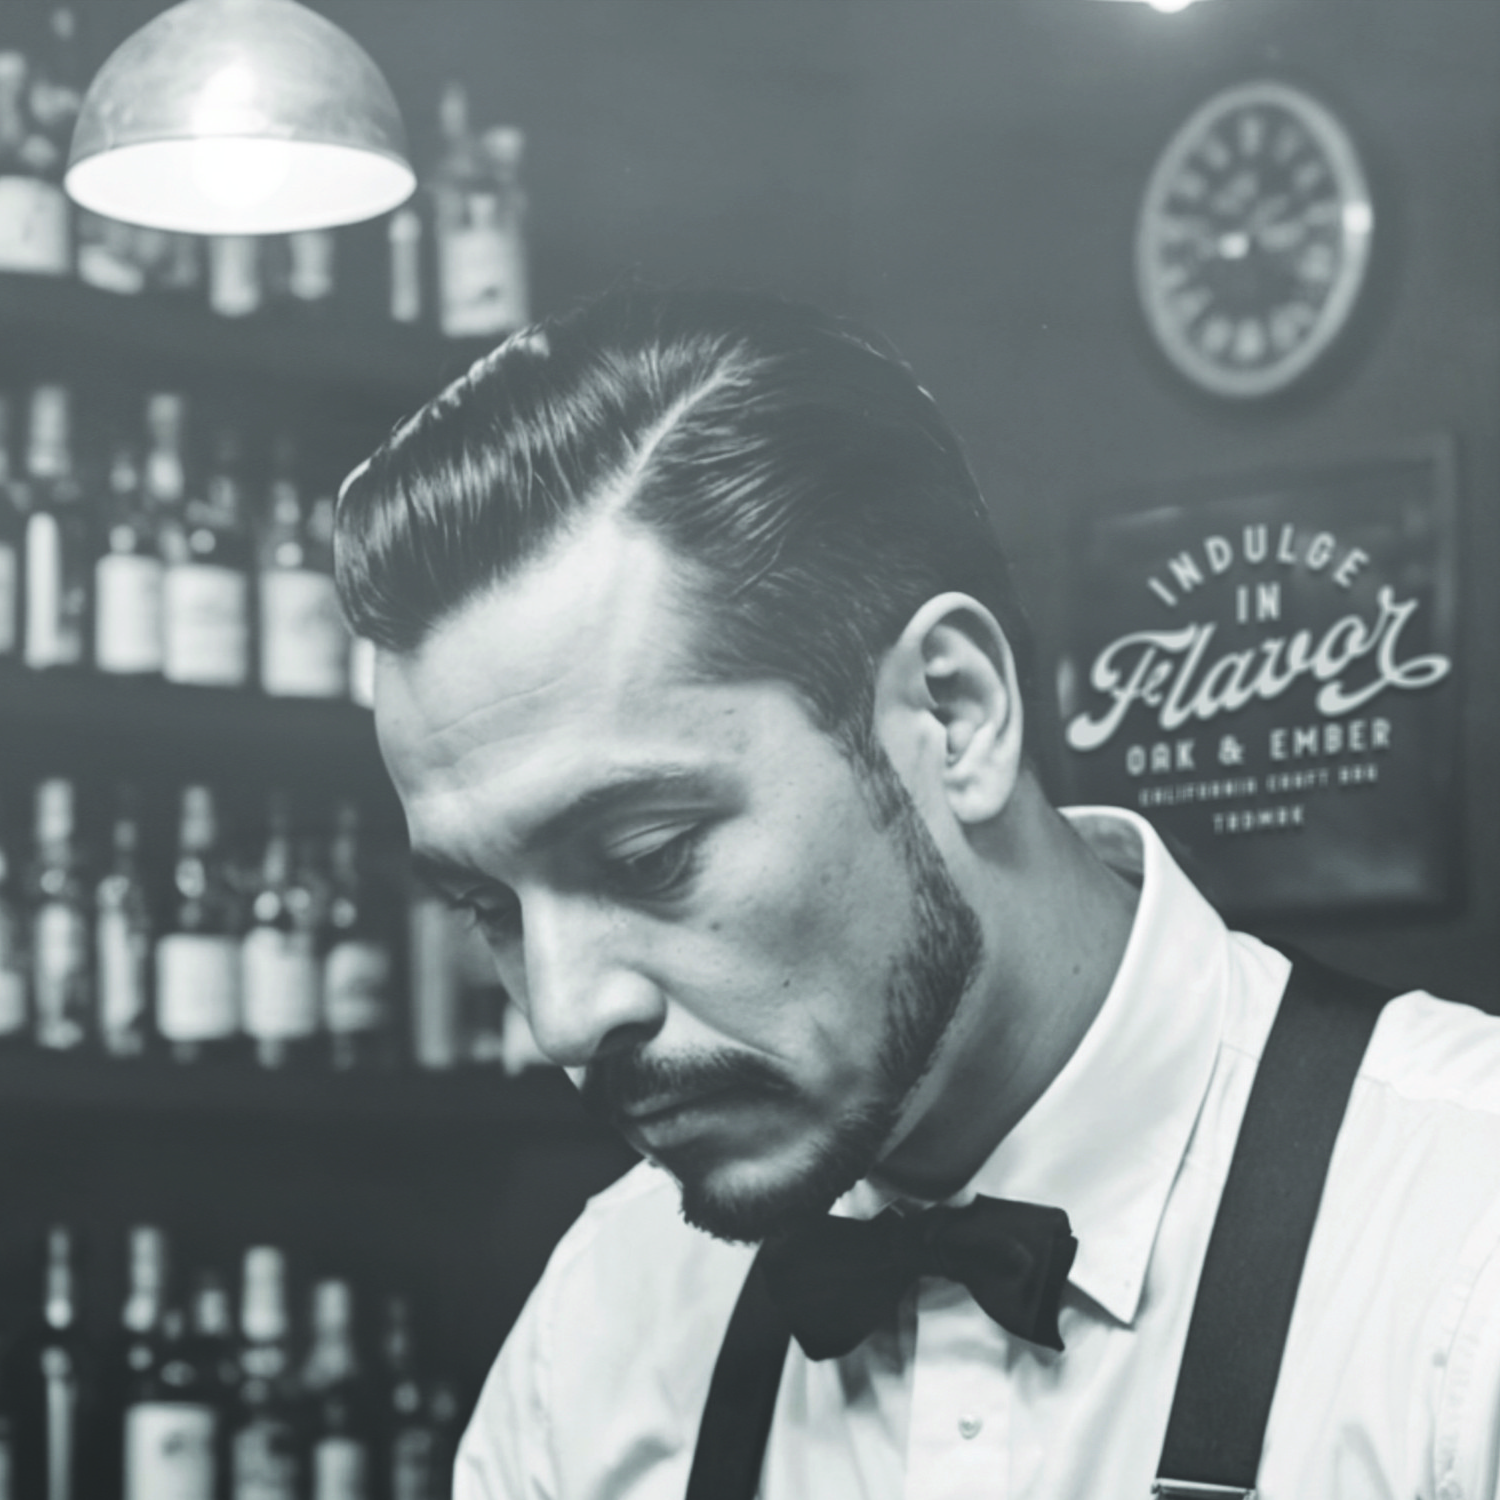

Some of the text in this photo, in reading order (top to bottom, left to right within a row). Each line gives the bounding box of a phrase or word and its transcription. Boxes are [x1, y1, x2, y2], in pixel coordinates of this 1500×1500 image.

[1146, 522, 1370, 607] INDULGE
[1236, 582, 1281, 623] IN
[1065, 584, 1451, 750] Flavor
[1126, 717, 1391, 776] OAK & EMBER
[1138, 777, 1258, 806] CALIFORNIA
[1266, 767, 1330, 793] CRAFT
